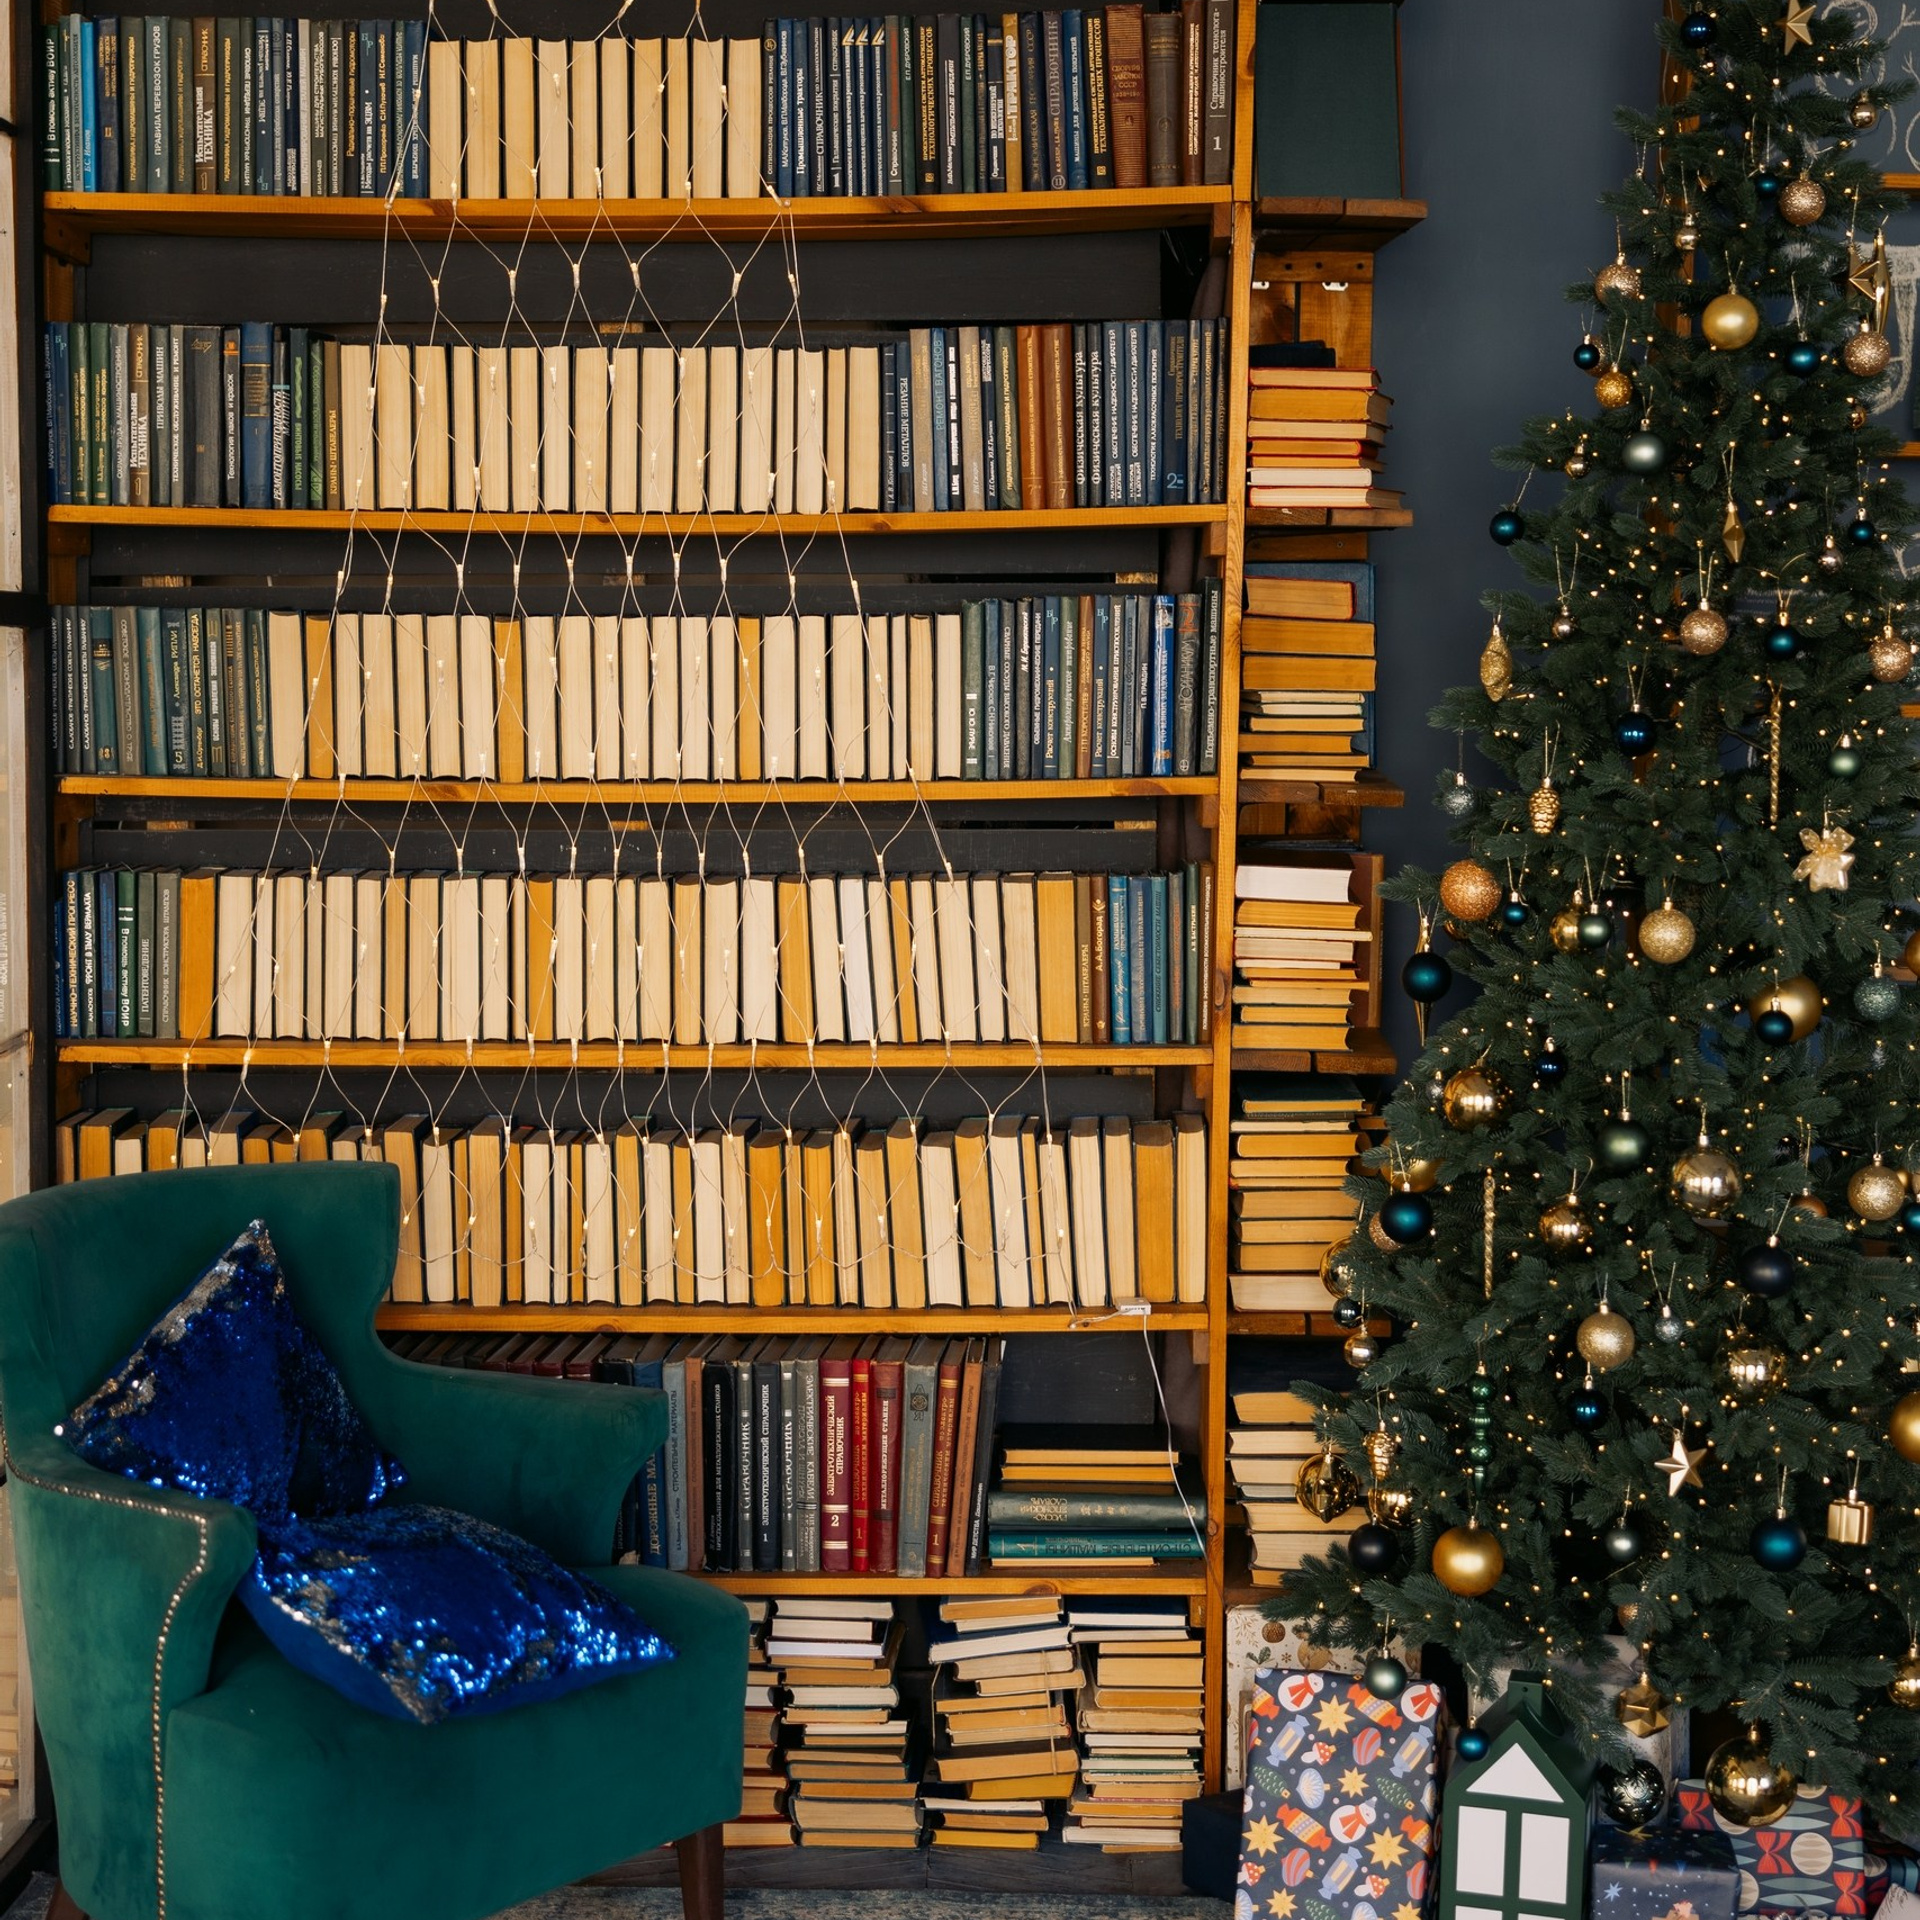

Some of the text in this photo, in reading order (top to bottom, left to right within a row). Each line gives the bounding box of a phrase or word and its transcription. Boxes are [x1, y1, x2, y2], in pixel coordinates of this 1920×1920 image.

[46, 38, 55, 67] ВОИР
[48, 70, 56, 98] активу
[1006, 35, 1017, 114] ТРАКТОР
[1048, 20, 1060, 115] СПРАВОЧНИК
[1094, 18, 1106, 153] ТЕХНОЛОГИЧЕСКИХ ПРОЦЕССОВ
[1210, 57, 1219, 109] Справочник
[196, 87, 204, 163] Испытательная
[204, 110, 213, 162] ТЕХНИКА
[796, 68, 805, 174] Промышленные тракторы
[815, 91, 824, 154] СПРАВОЧНИК
[1030, 109, 1040, 181] ЭКОНОМИЧЕСКАЯ
[156, 346, 164, 429] ПРИВОДЫ МАШИН
[227, 374, 235, 401] красок
[934, 340, 944, 430] РЕМОНТ ВАГОНОВ
[1075, 351, 1085, 484] Физическая культура
[1090, 351, 1101, 484] Физическая культура
[138, 415, 147, 468] ТЕХНИКА
[273, 391, 282, 500] РЕМОНТОПРИГОДНОСТЬ
[900, 378, 909, 467] РЕЗАНИЕ МЕТАЛЛОВ
[227, 437, 235, 480] Технология
[192, 614, 200, 651] НАВСЕГДА
[1046, 679, 1055, 730] конструкций
[1064, 621, 1074, 742] Амперометрическое титрование
[1096, 679, 1105, 730] конструкций
[1180, 638, 1194, 711] АНОРГАНИКУМ
[1205, 590, 1219, 758] Подъемно-транспортные машины
[176, 751, 182, 763] 5
[84, 892, 92, 929] ВЕРМАХТА
[84, 931, 93, 950] ТЫЛУ
[67, 880, 77, 1026] НАУЧНО-ТЕХНИЧЕСКИЙ ПРОГРЕСС
[85, 959, 93, 984] ФРОНТ
[120, 969, 128, 997] активу
[141, 939, 149, 1012] ПАТЕНТОВЕДЕНИЕ
[121, 999, 129, 1026] ВОИР
[806, 1375, 815, 1455] ЭЛЕКТРИЧЕСКИЕ
[825, 1395, 835, 1496] ЭЛЕКТРОТЕХНИЧЕСКИЙ
[836, 1417, 844, 1475] СПРАВОЧНИК
[761, 1384, 770, 1526] ЭЛЕКТРОТЕХНИЧЕСКИЙ СПРАВОЧНИК
[880, 1401, 889, 1509] МЕТАЛЛОРЕЖУЩИЕ СТАНКИ
[931, 1451, 943, 1507] СПРАВОЧНИК
[941, 1398, 955, 1507] техническим материалам
[647, 1483, 661, 1554] ДОРОЖНЫЕ
[972, 1519, 980, 1546] ДЕТСТВА
[1045, 1543, 1191, 1555] СТРОИТЕЛЬНЫЕ МАШИНЫ
